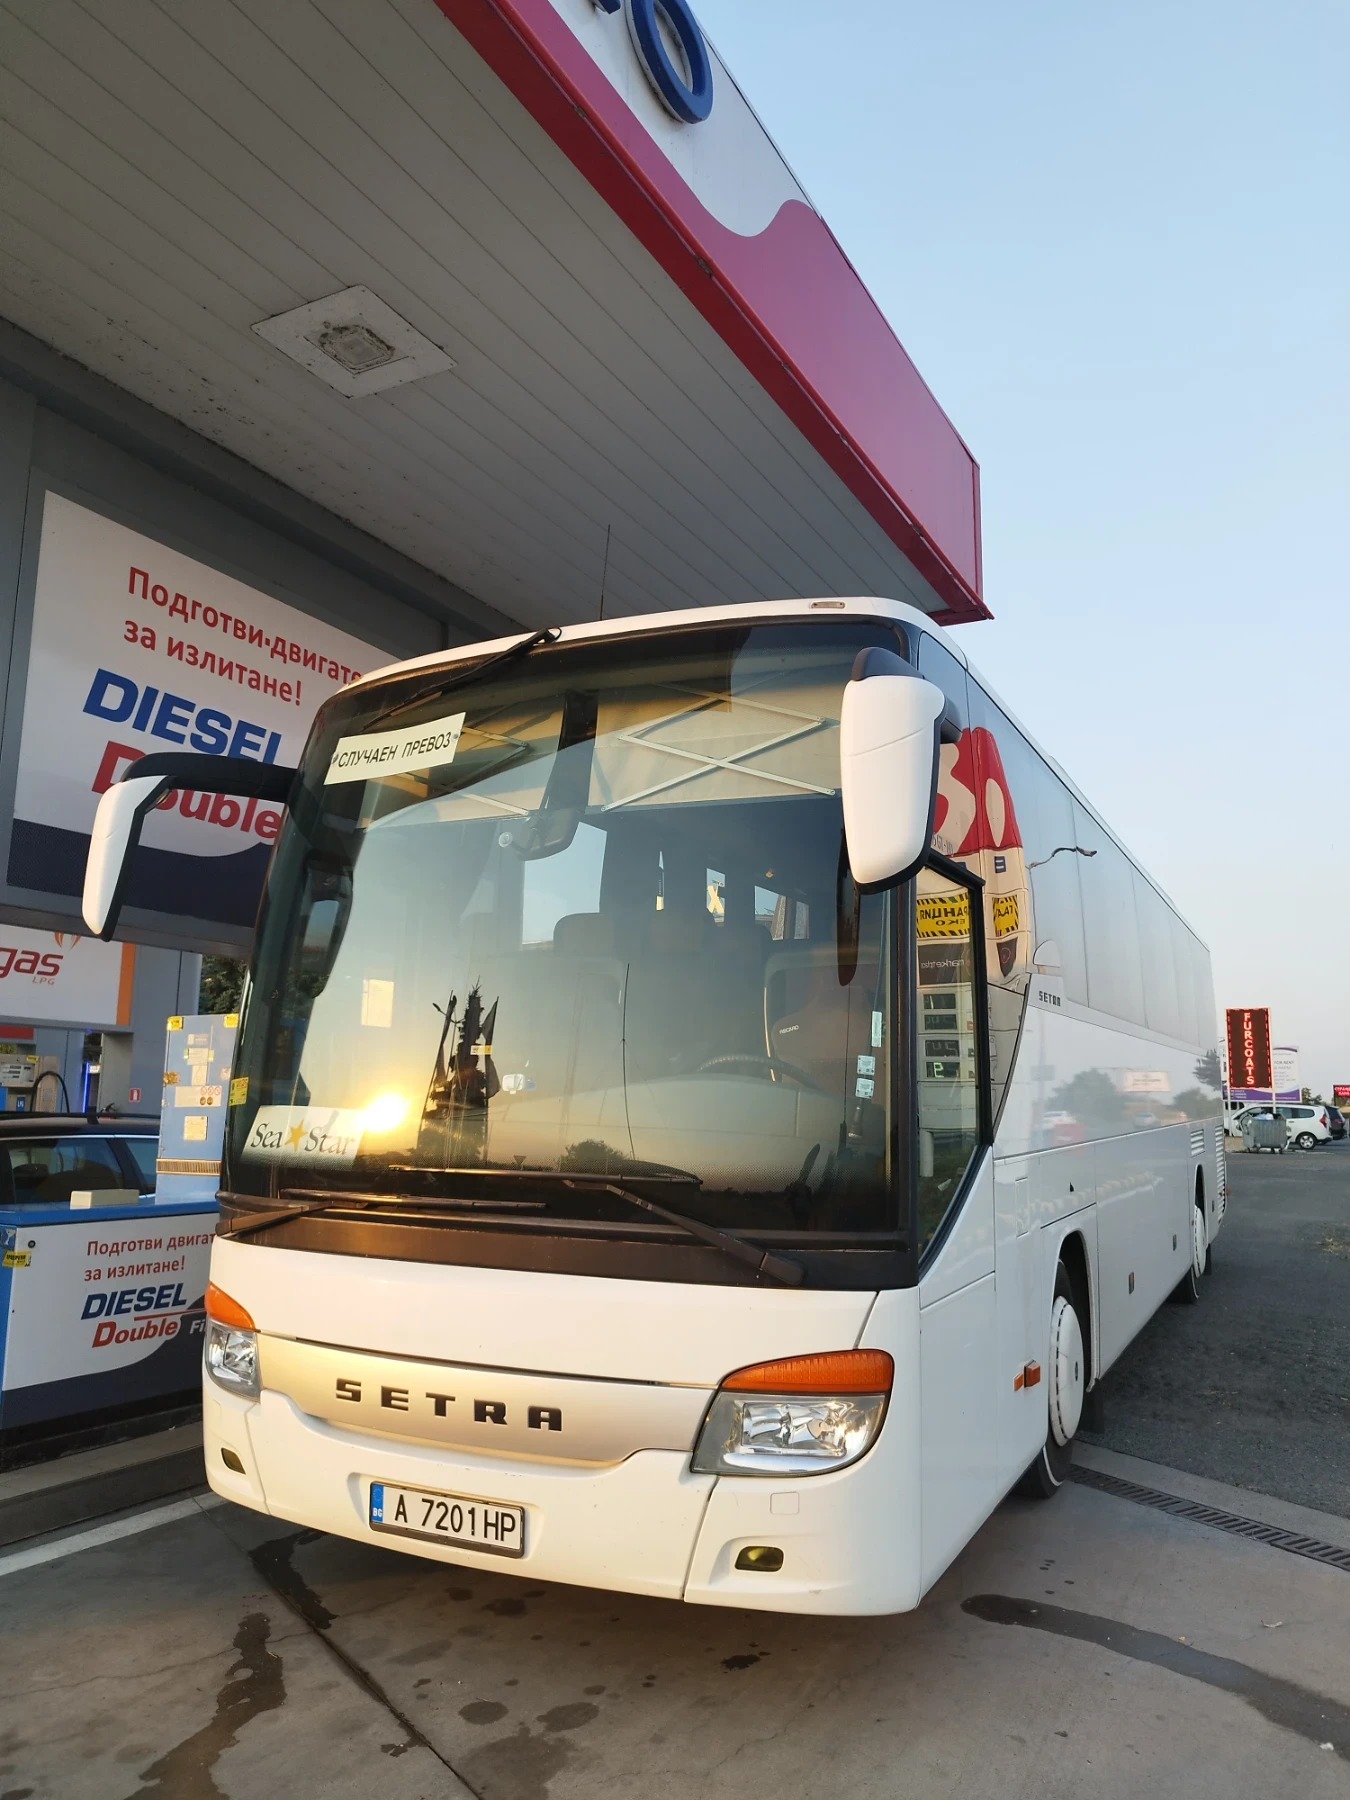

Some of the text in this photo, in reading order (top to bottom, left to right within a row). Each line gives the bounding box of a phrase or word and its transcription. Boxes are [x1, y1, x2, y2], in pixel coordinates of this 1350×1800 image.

[123, 620, 303, 707] за излитане!
[338, 731, 451, 767] СЛУЧАЕН ПРЕВОЗ
[32, 976, 55, 985] LPG
[250, 1122, 357, 1156] Sea Star
[86, 1237, 163, 1257] Подготви
[84, 1255, 186, 1282] за излитане!
[81, 1282, 188, 1320] DIESEL
[91, 1317, 180, 1349] Double
[335, 1377, 563, 1432] SETRA
[372, 1506, 383, 1518] BG
[394, 1494, 408, 1523] A
